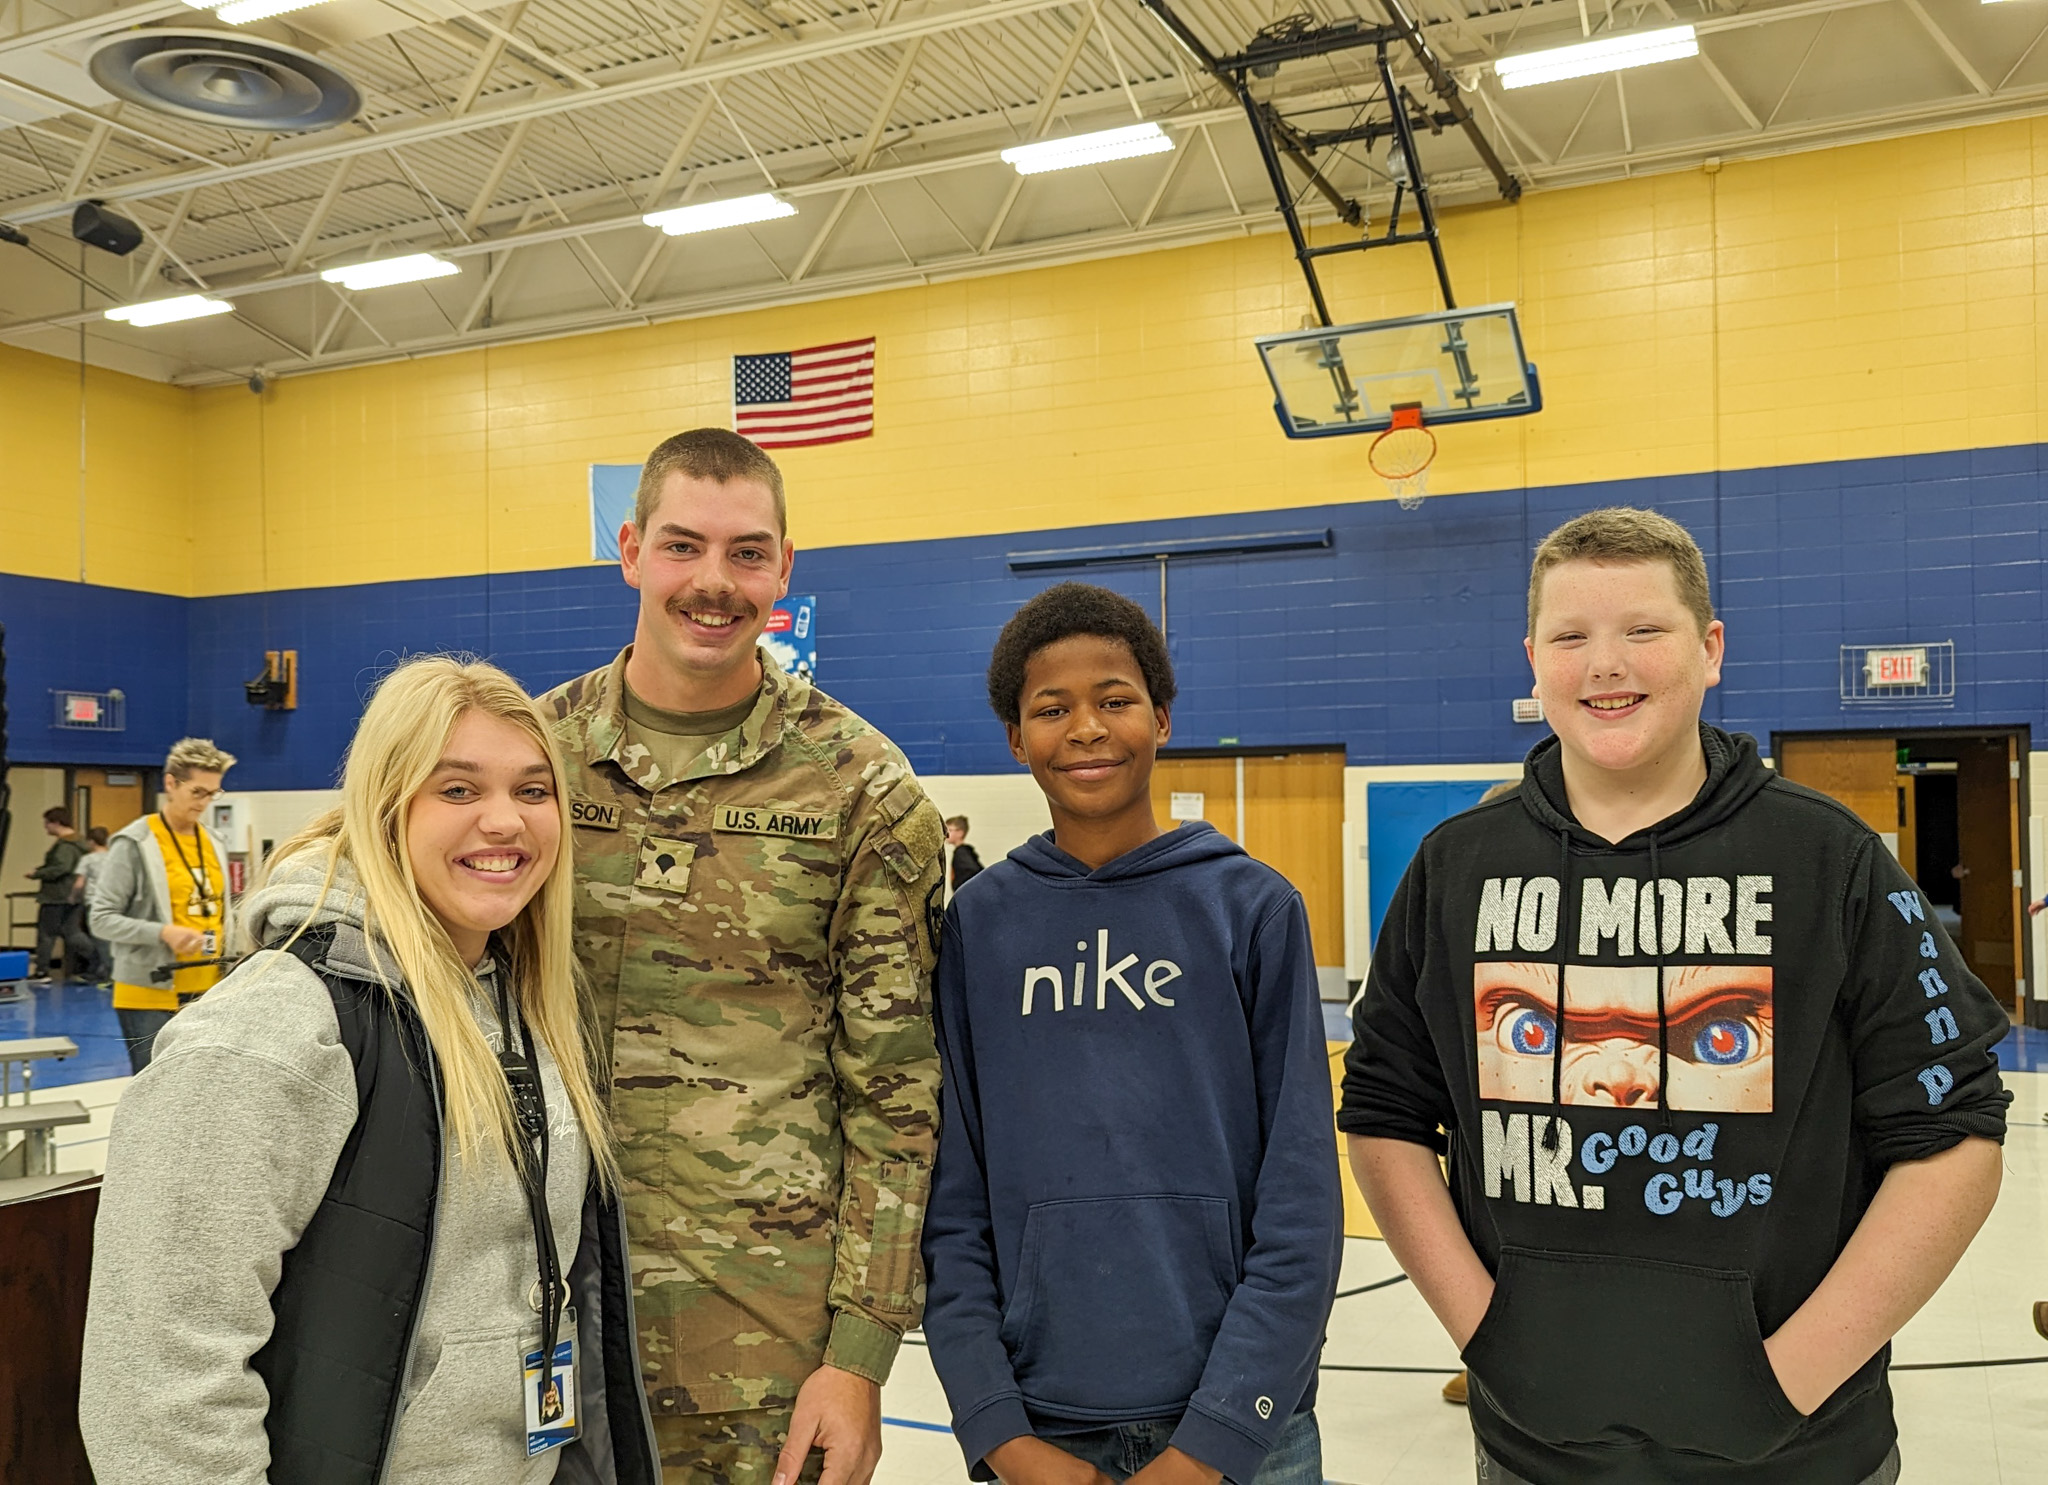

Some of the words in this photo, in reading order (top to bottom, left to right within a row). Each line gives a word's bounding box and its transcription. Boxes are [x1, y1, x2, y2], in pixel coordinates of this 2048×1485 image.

[1880, 655, 1913, 681] EXIT
[725, 810, 760, 831] U.S.
[766, 814, 823, 836] ARMY
[1474, 875, 1561, 953] NO
[1578, 874, 1774, 957] MORE
[1021, 928, 1184, 1016] nike
[1481, 1109, 1605, 1211] MR.
[1580, 1122, 1720, 1175] Good
[1644, 1168, 1773, 1218] Guys
